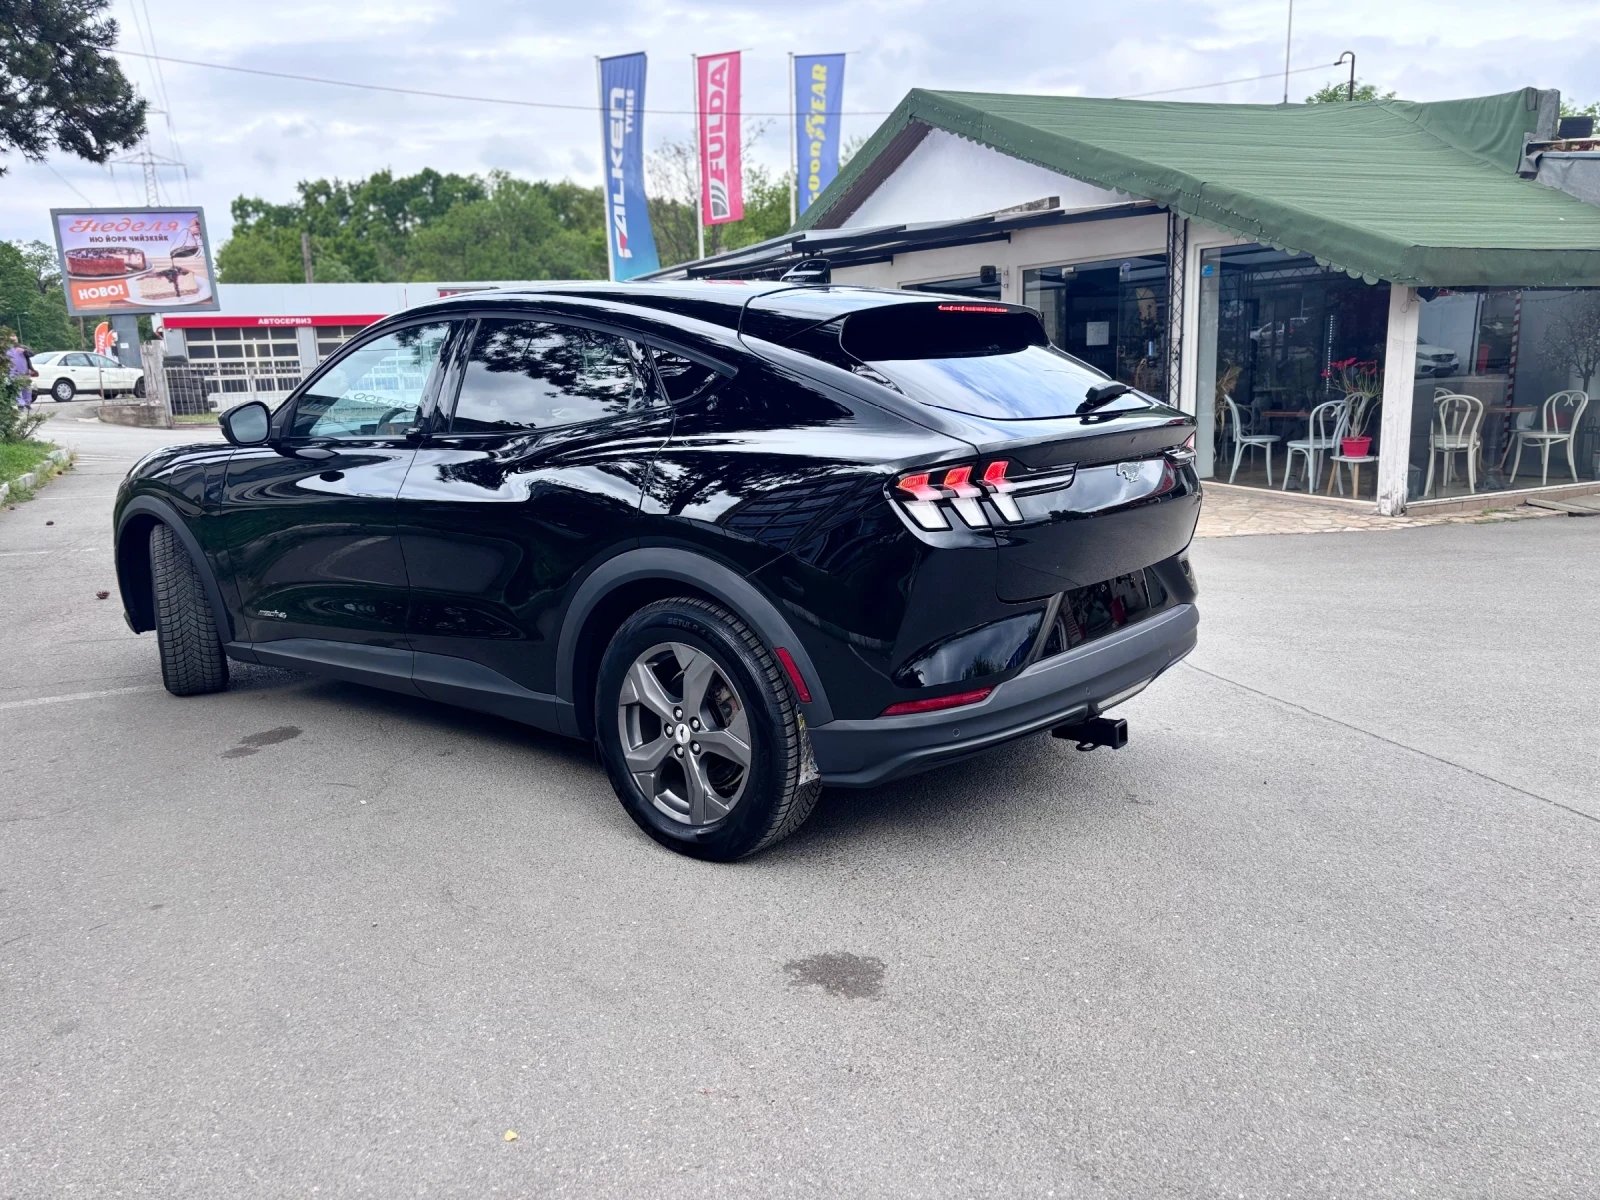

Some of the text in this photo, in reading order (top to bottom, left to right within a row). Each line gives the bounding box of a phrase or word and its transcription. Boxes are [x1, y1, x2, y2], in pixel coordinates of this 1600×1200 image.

[625, 88, 635, 134] TYRES
[710, 61, 727, 186] FULDA
[610, 87, 633, 259] FALKEN
[68, 216, 179, 233] Неделя
[89, 233, 169, 244] НЮ ЙОРК ЧИЙЗКЕЙК
[78, 284, 125, 300] НОВО!
[258, 317, 312, 325] АВТОСЕРВИЗ
